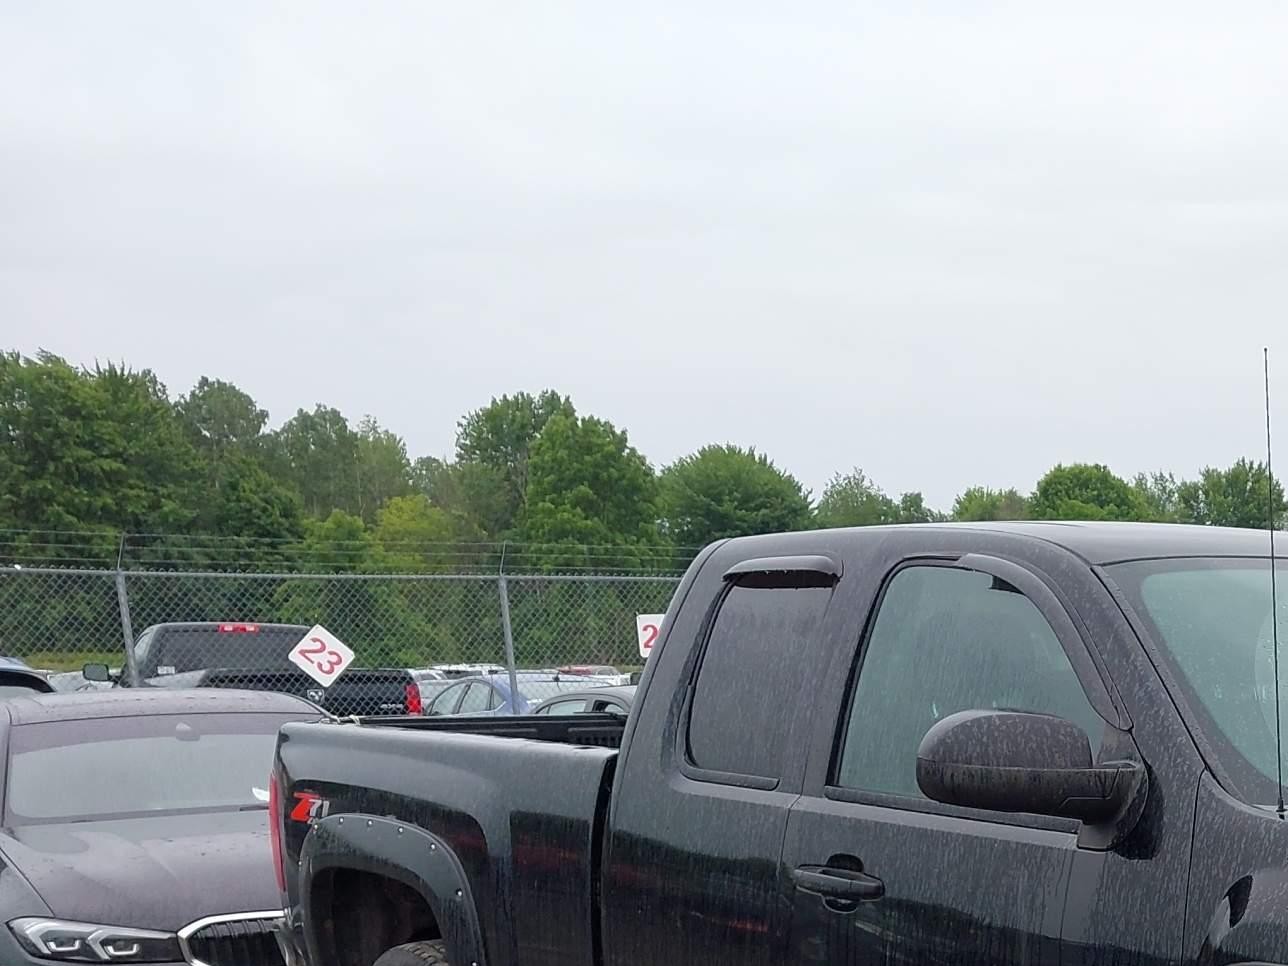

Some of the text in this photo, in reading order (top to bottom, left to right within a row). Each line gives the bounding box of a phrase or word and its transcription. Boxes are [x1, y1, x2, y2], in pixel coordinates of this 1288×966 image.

[643, 624, 658, 649] 2
[298, 637, 343, 675] 23
[290, 791, 330, 822] Z71
